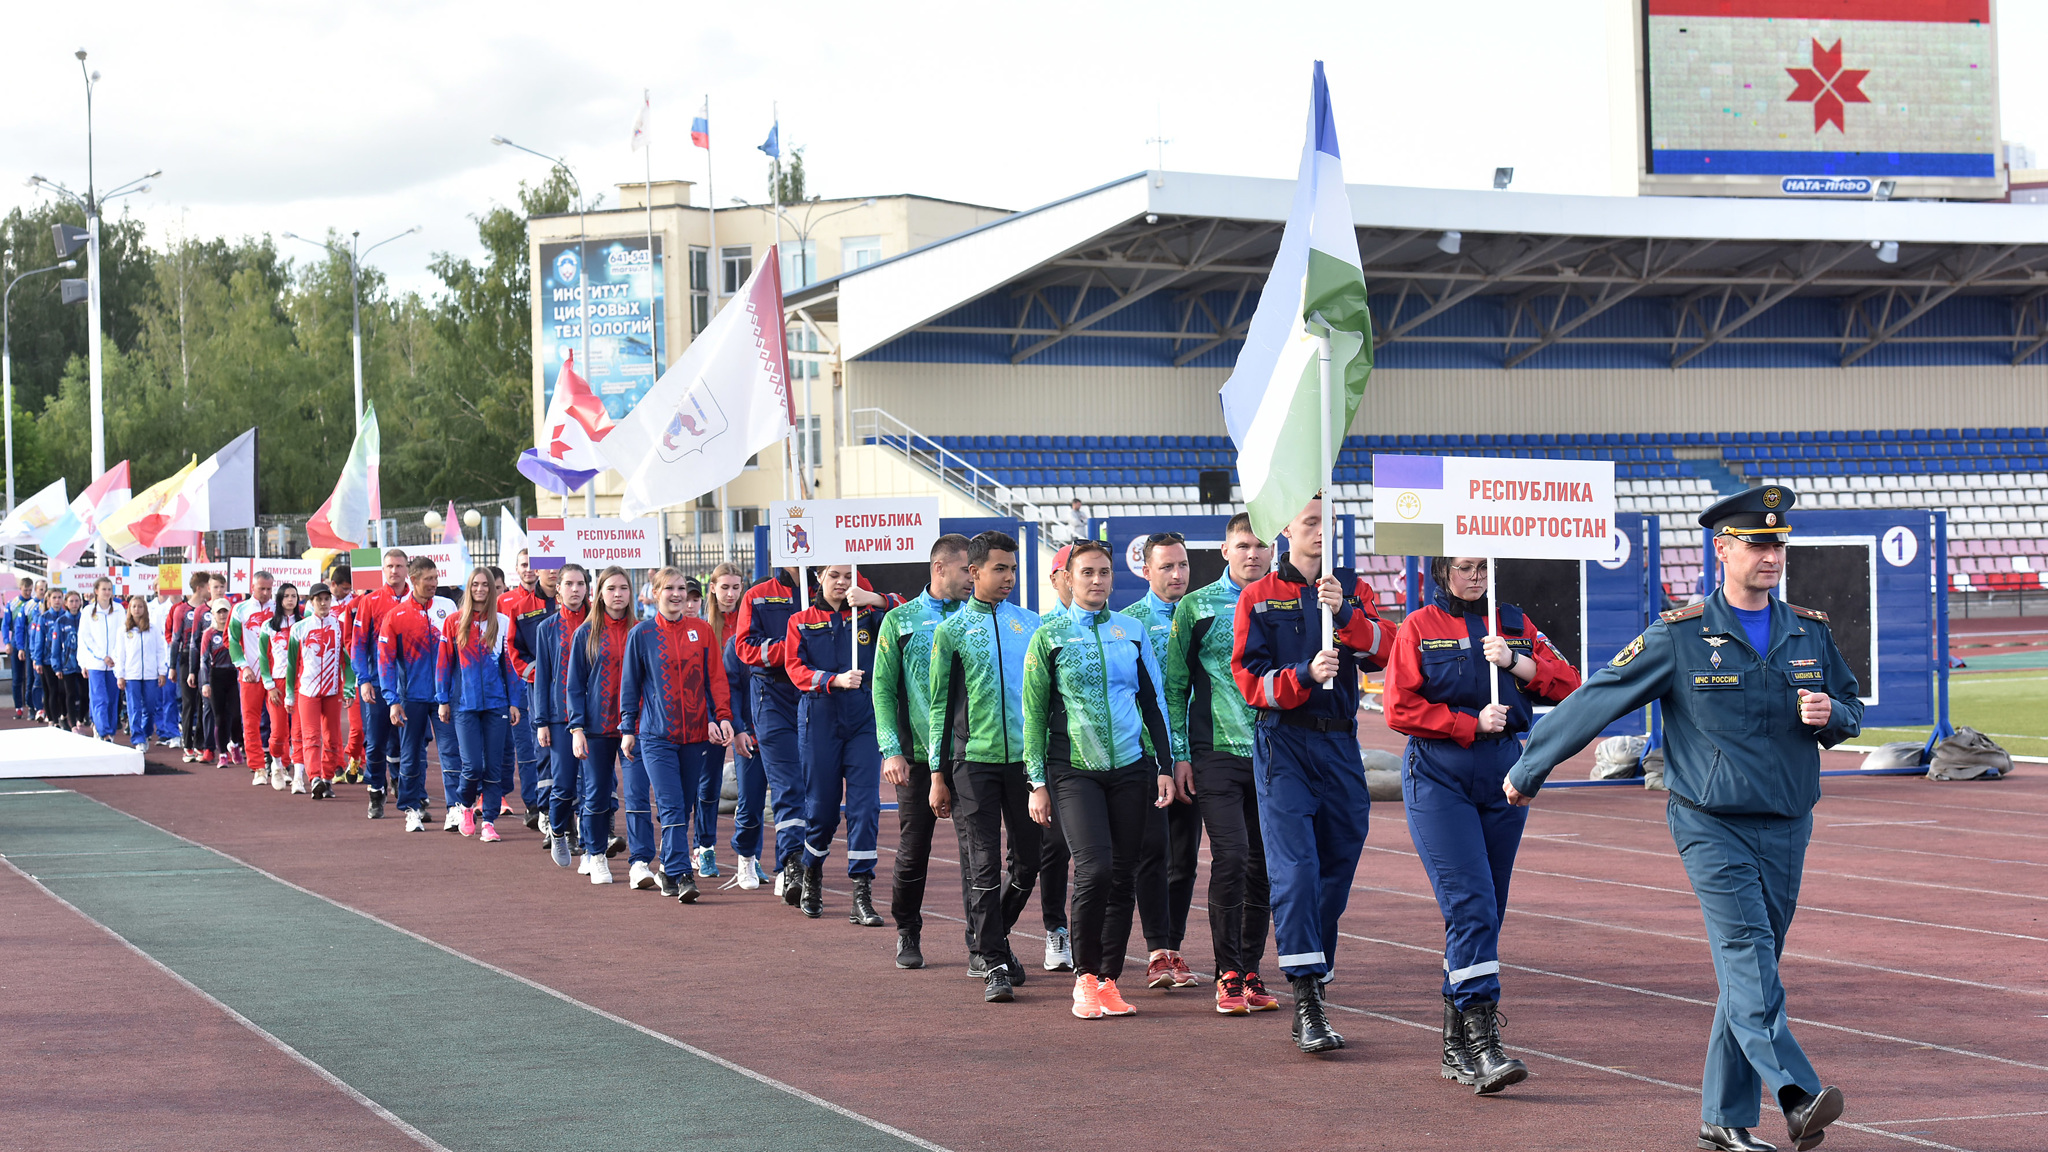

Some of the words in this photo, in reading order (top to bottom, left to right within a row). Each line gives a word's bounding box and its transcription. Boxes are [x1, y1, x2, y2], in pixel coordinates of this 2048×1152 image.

[609, 250, 650, 264] 641-541
[611, 265, 649, 274] marsu.ru
[554, 316, 651, 338] ТЕХОЛОГИЙ
[1469, 479, 1593, 502] РЕСПУБЛИКА
[835, 513, 922, 528] РЕСПУБЛИКА
[1456, 515, 1606, 538] БАШКОРТОСТАН
[577, 529, 645, 540] РЕСПУБЛИКА
[845, 535, 892, 552] МАРИЙ
[896, 537, 914, 551] ЭЛ
[1892, 531, 1904, 560] 1
[583, 547, 641, 560] МОРДОВИЯ
[1695, 676, 1709, 684] МЧС
[1712, 675, 1738, 684] РОССИИ
